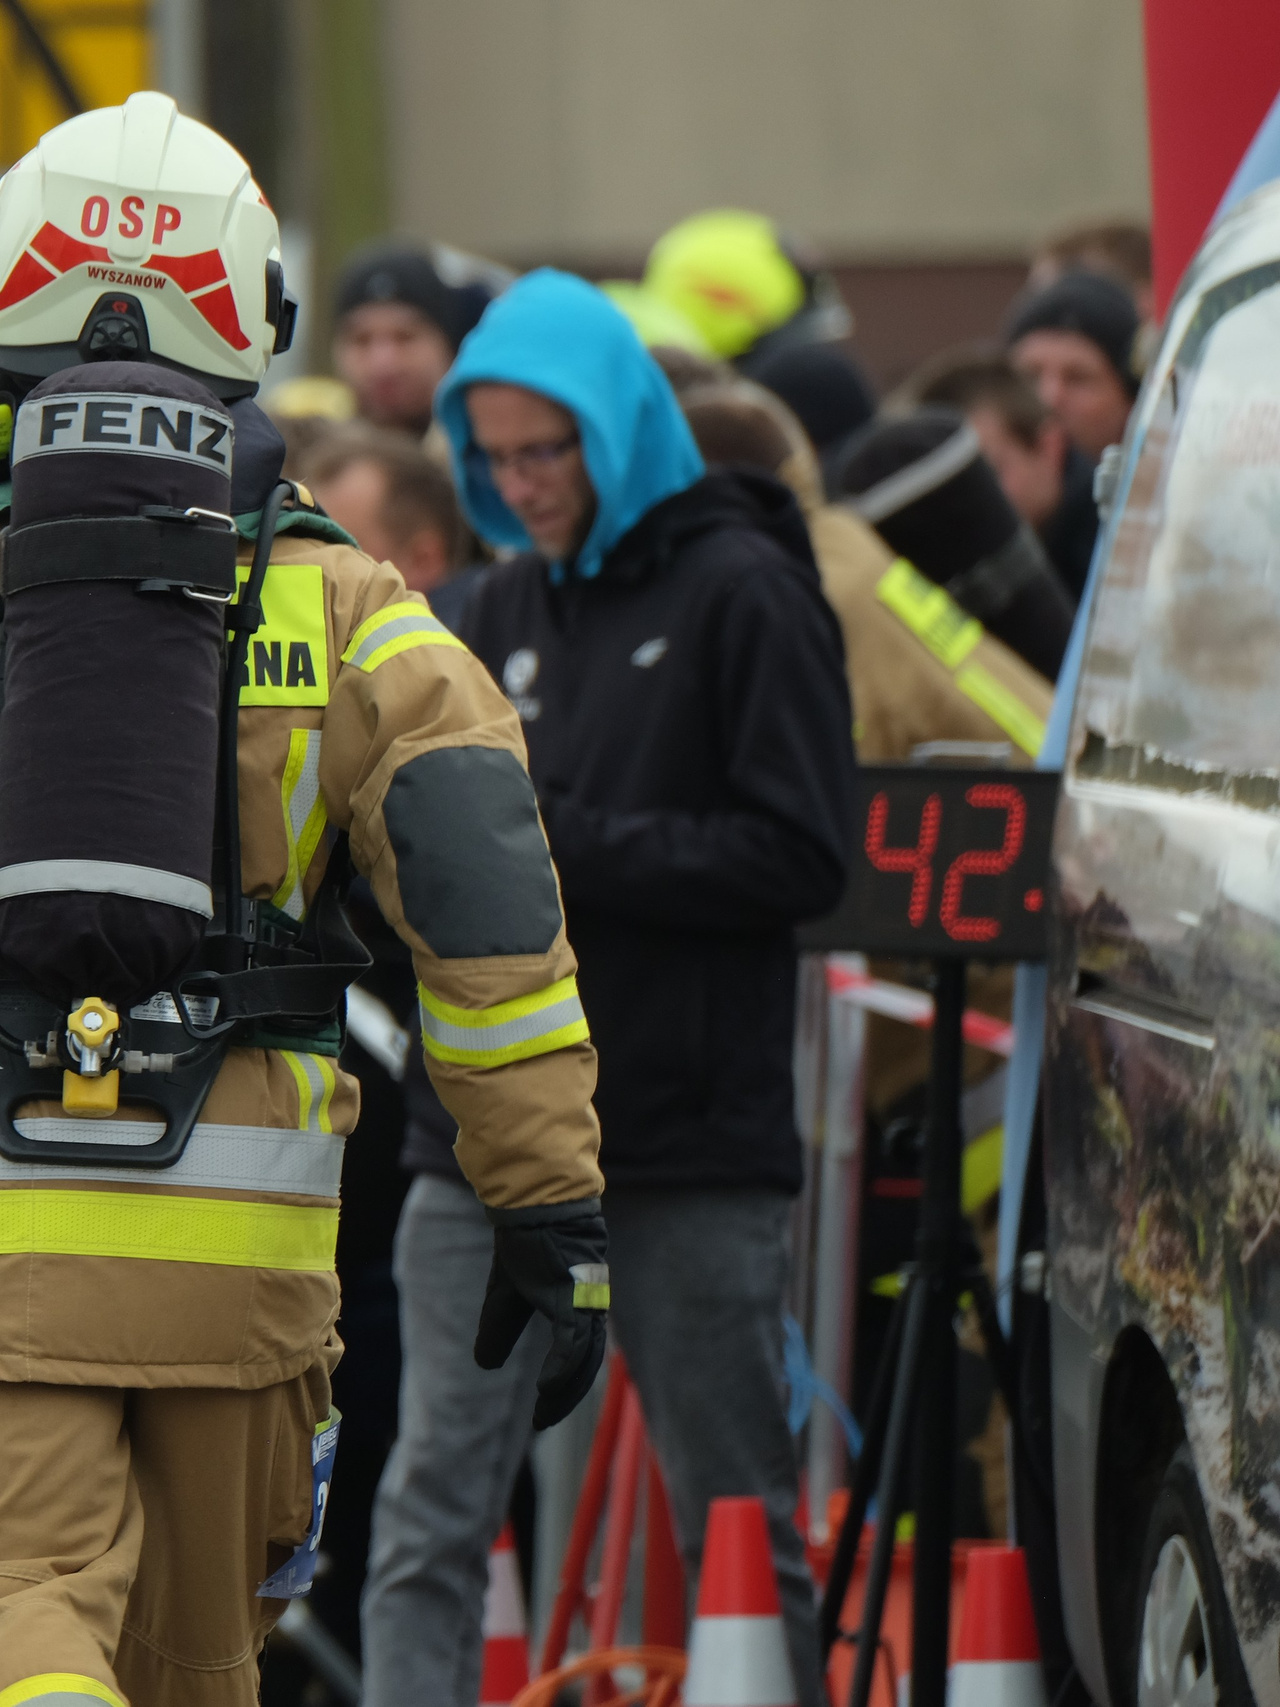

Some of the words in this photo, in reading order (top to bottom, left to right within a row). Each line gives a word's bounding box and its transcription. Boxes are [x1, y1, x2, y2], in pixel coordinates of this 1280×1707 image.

[80, 195, 182, 245] OSP
[87, 265, 167, 290] WYSZANÓW
[39, 401, 228, 466] FENZ
